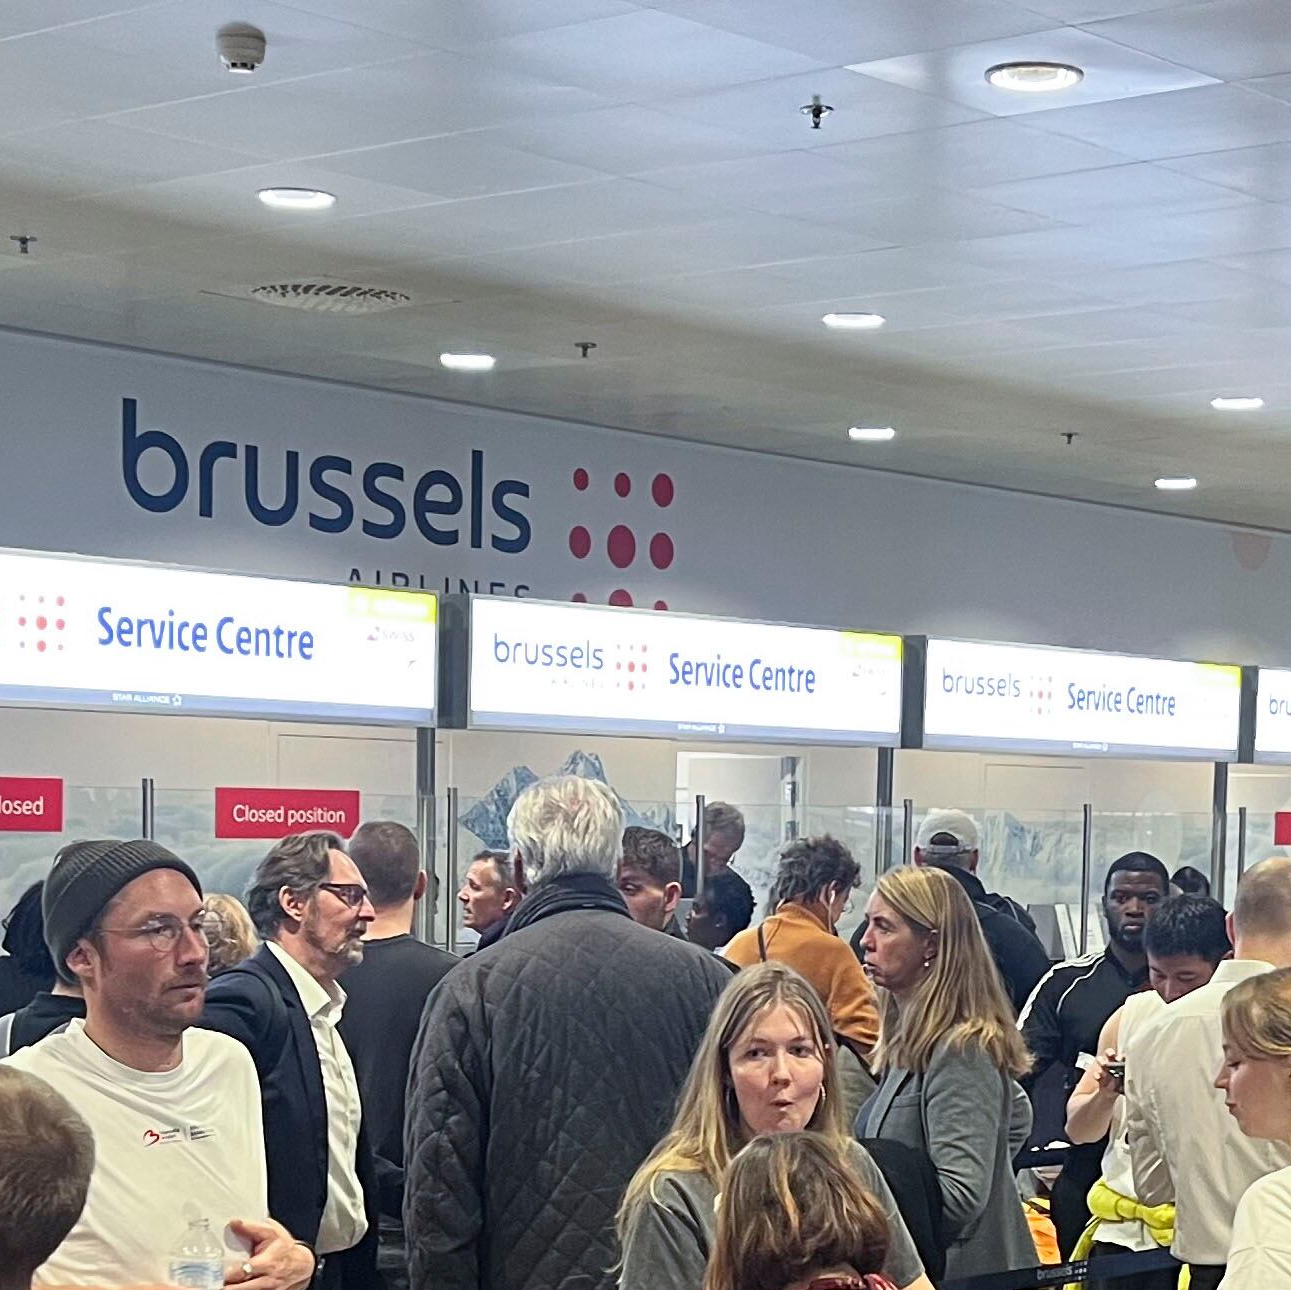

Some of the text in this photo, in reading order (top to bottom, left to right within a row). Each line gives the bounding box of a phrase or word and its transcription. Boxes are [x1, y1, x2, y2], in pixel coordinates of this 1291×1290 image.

[122, 398, 531, 554] brussels
[98, 606, 314, 660] Service Centre
[494, 633, 604, 669] brussels
[670, 652, 816, 693] Service Centre
[942, 668, 1021, 697] brussels
[1068, 683, 1176, 716] Service Centre
[233, 804, 345, 826] Closed position
